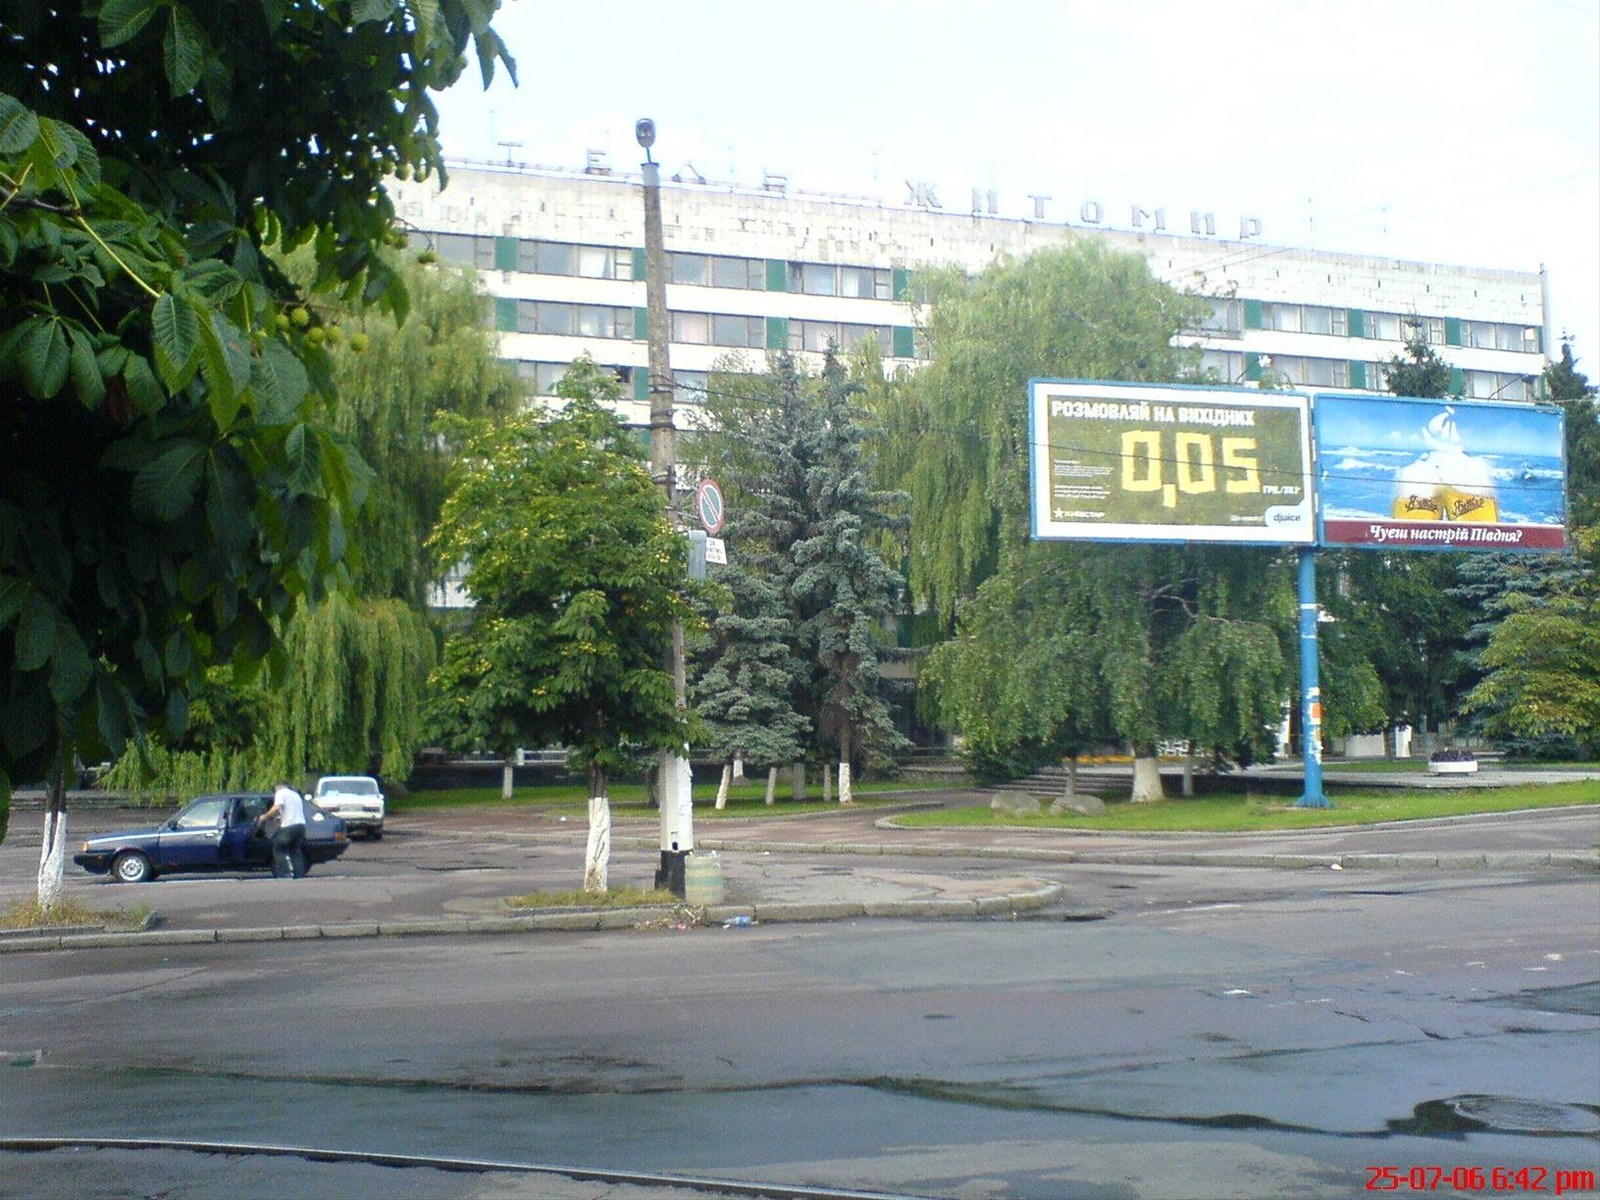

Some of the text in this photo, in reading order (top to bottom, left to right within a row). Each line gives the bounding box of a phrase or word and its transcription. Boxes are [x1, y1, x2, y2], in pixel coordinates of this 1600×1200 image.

[904, 181, 1263, 239] ЖИТОМИР
[1051, 400, 1256, 427] РОЗМОВЛЯЙ НА ВИХІДНИХ
[1121, 430, 1262, 509] 0,05
[1273, 512, 1301, 524] djuice
[1410, 528, 1468, 543] настрій
[1470, 527, 1523, 542] Півдня?
